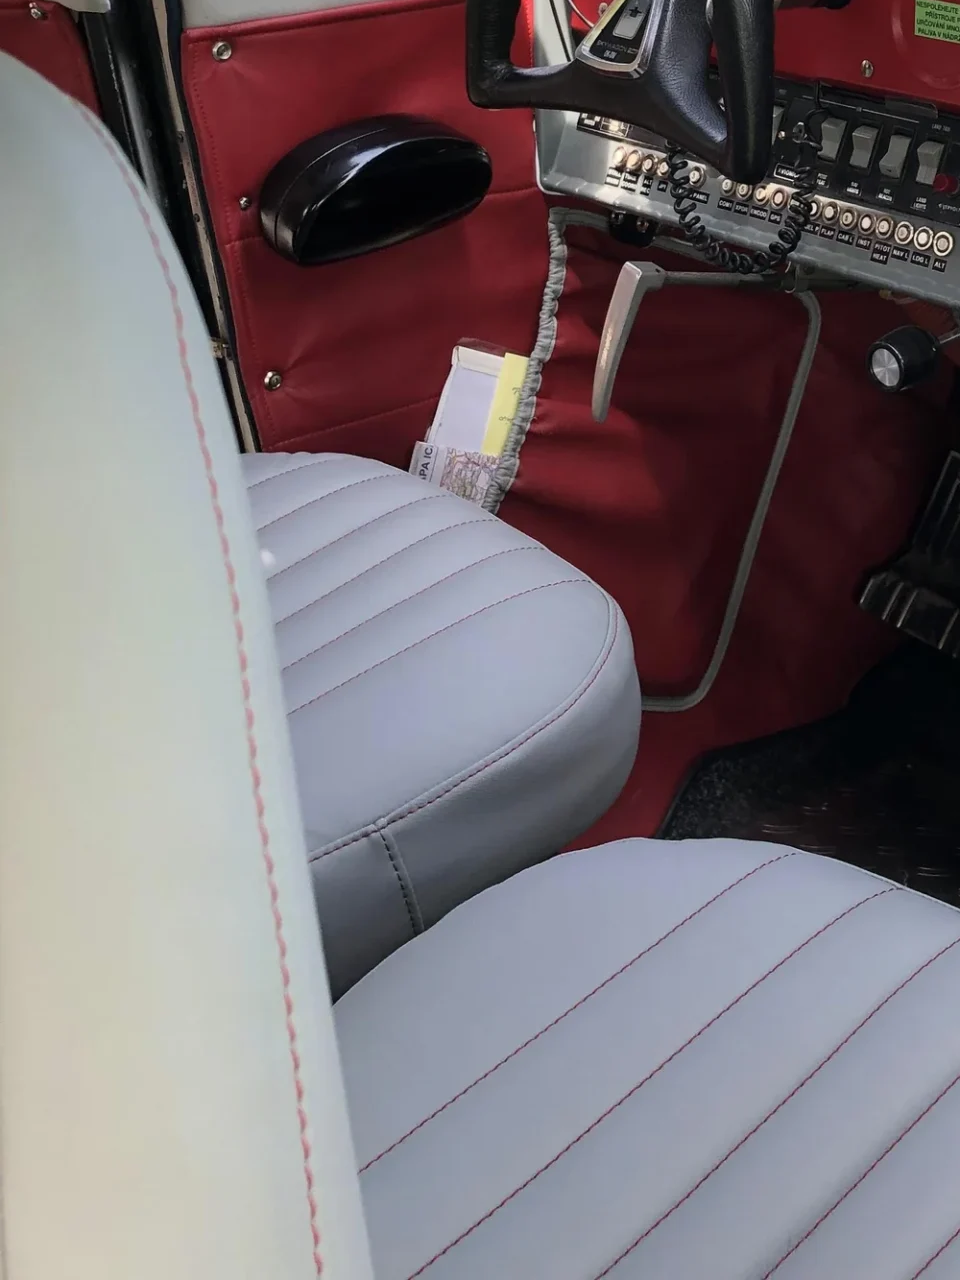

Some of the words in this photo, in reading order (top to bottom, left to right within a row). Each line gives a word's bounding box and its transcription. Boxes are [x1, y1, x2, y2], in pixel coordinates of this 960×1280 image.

[693, 192, 708, 201] PANEL
[719, 200, 733, 209] COM1
[750, 207, 767, 218] ENCOD
[770, 213, 781, 222] GPS
[820, 228, 834, 237] FLAP
[837, 232, 848, 241] CAB
[858, 238, 871, 247] INST
[875, 243, 890, 253] PITOT
[872, 252, 887, 262] HEAT
[892, 249, 904, 257] NAV
[934, 260, 945, 269] ALT
